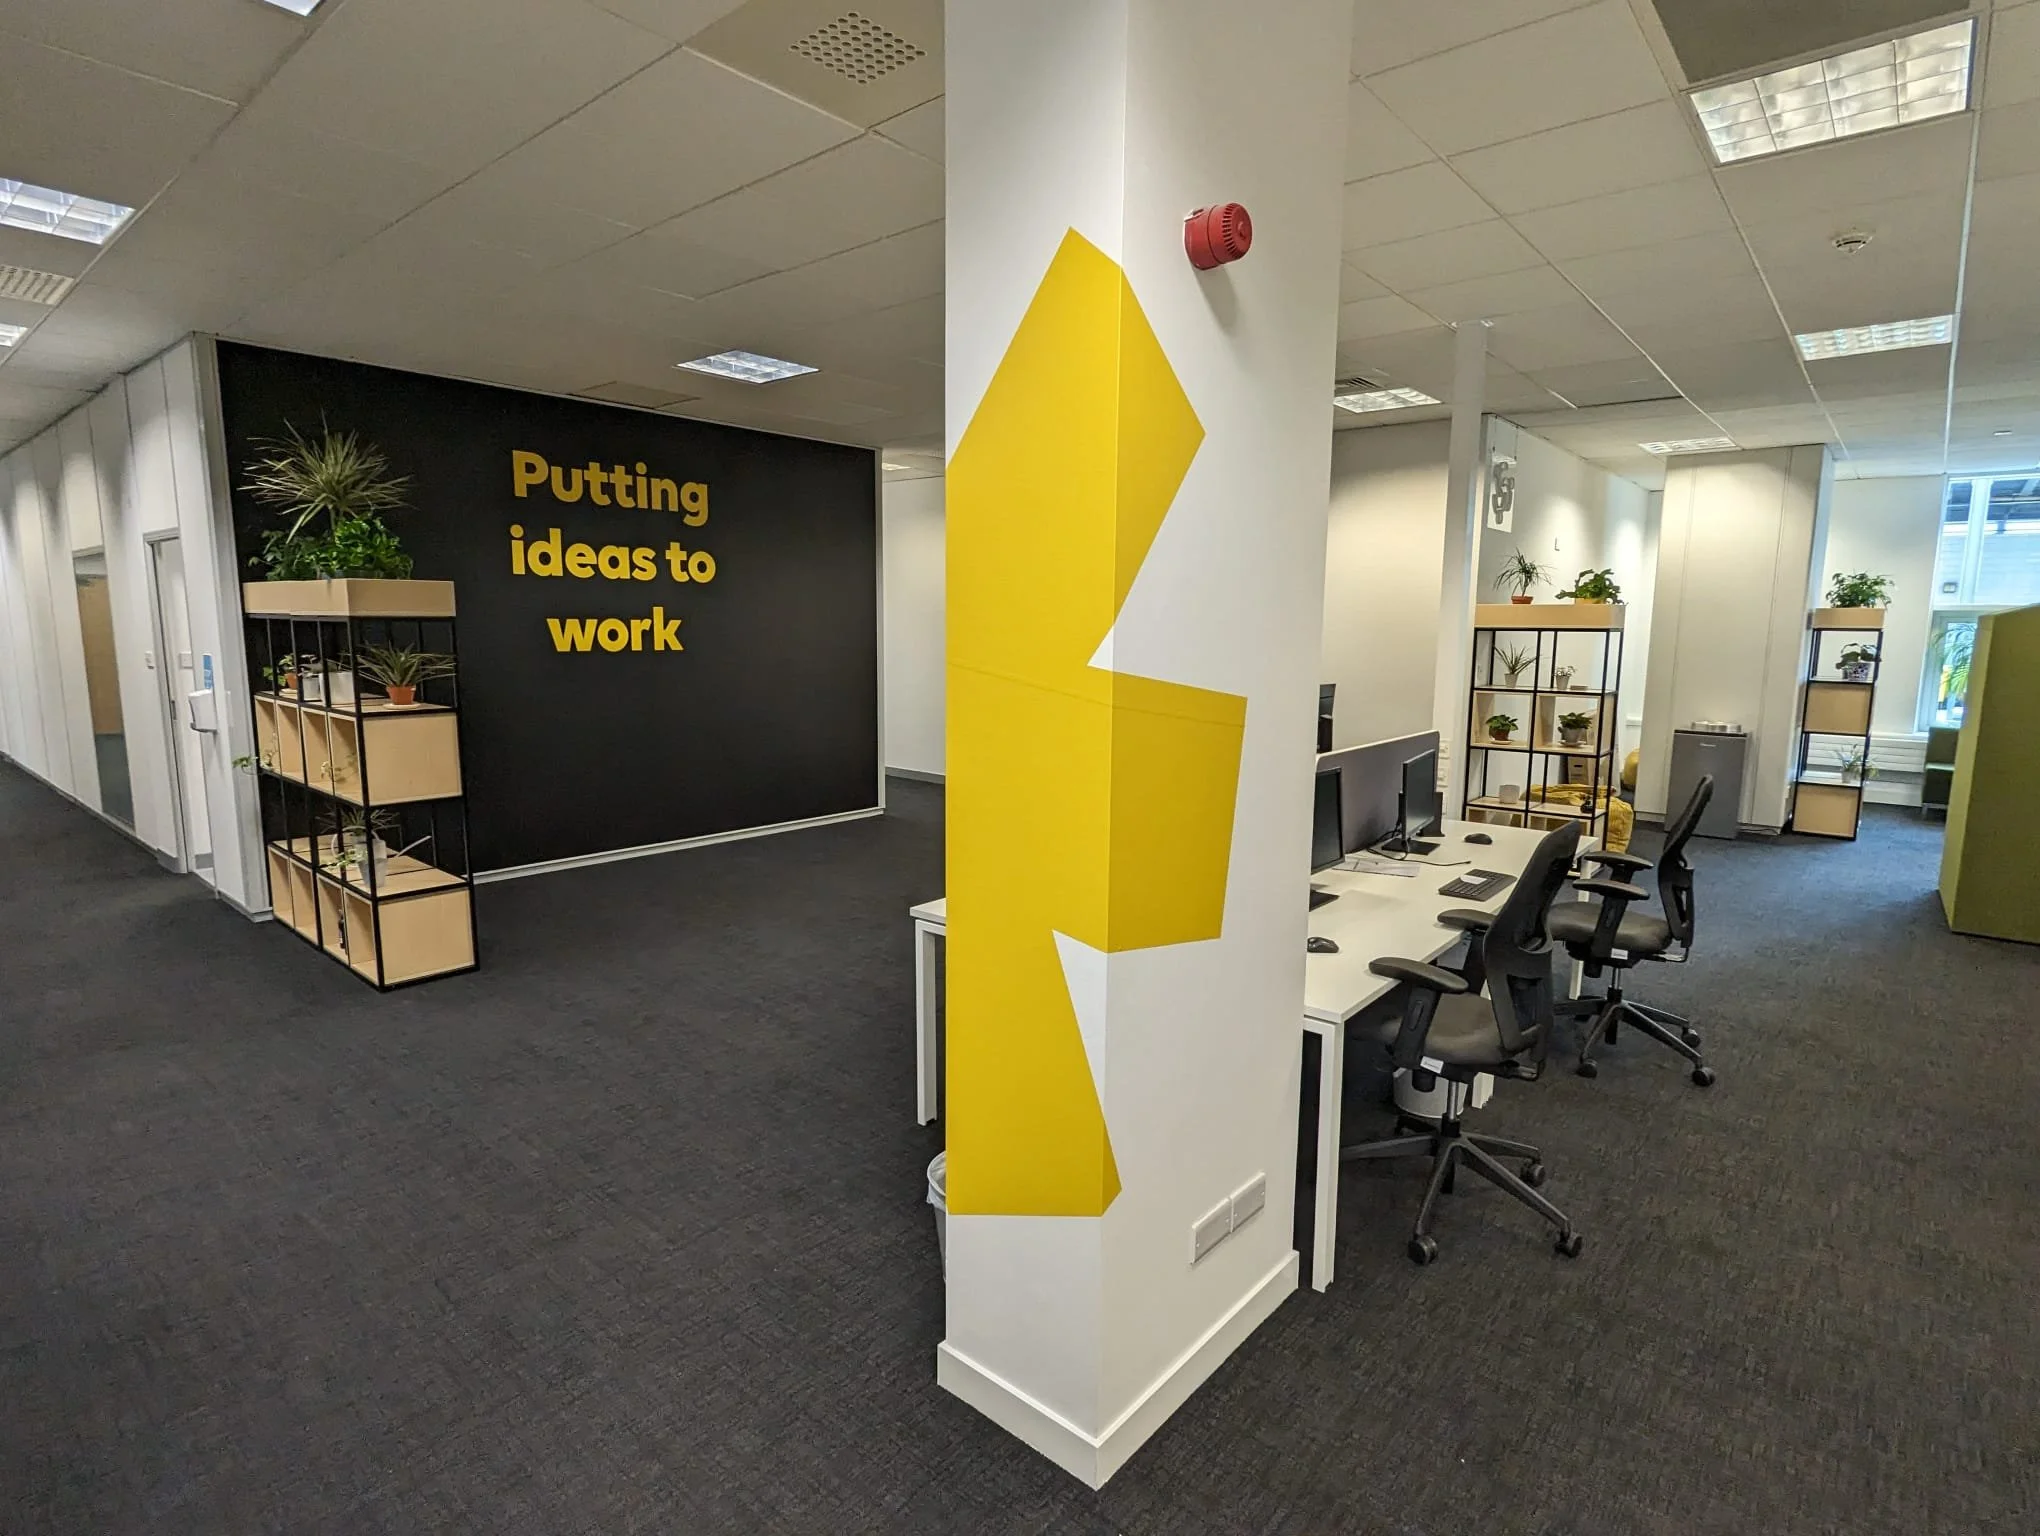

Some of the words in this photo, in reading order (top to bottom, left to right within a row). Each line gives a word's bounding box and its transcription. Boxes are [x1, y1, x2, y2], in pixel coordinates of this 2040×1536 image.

[512, 450, 709, 527] Putting
[510, 525, 657, 581] ideas
[665, 542, 716, 583] to
[546, 606, 684, 652] work
